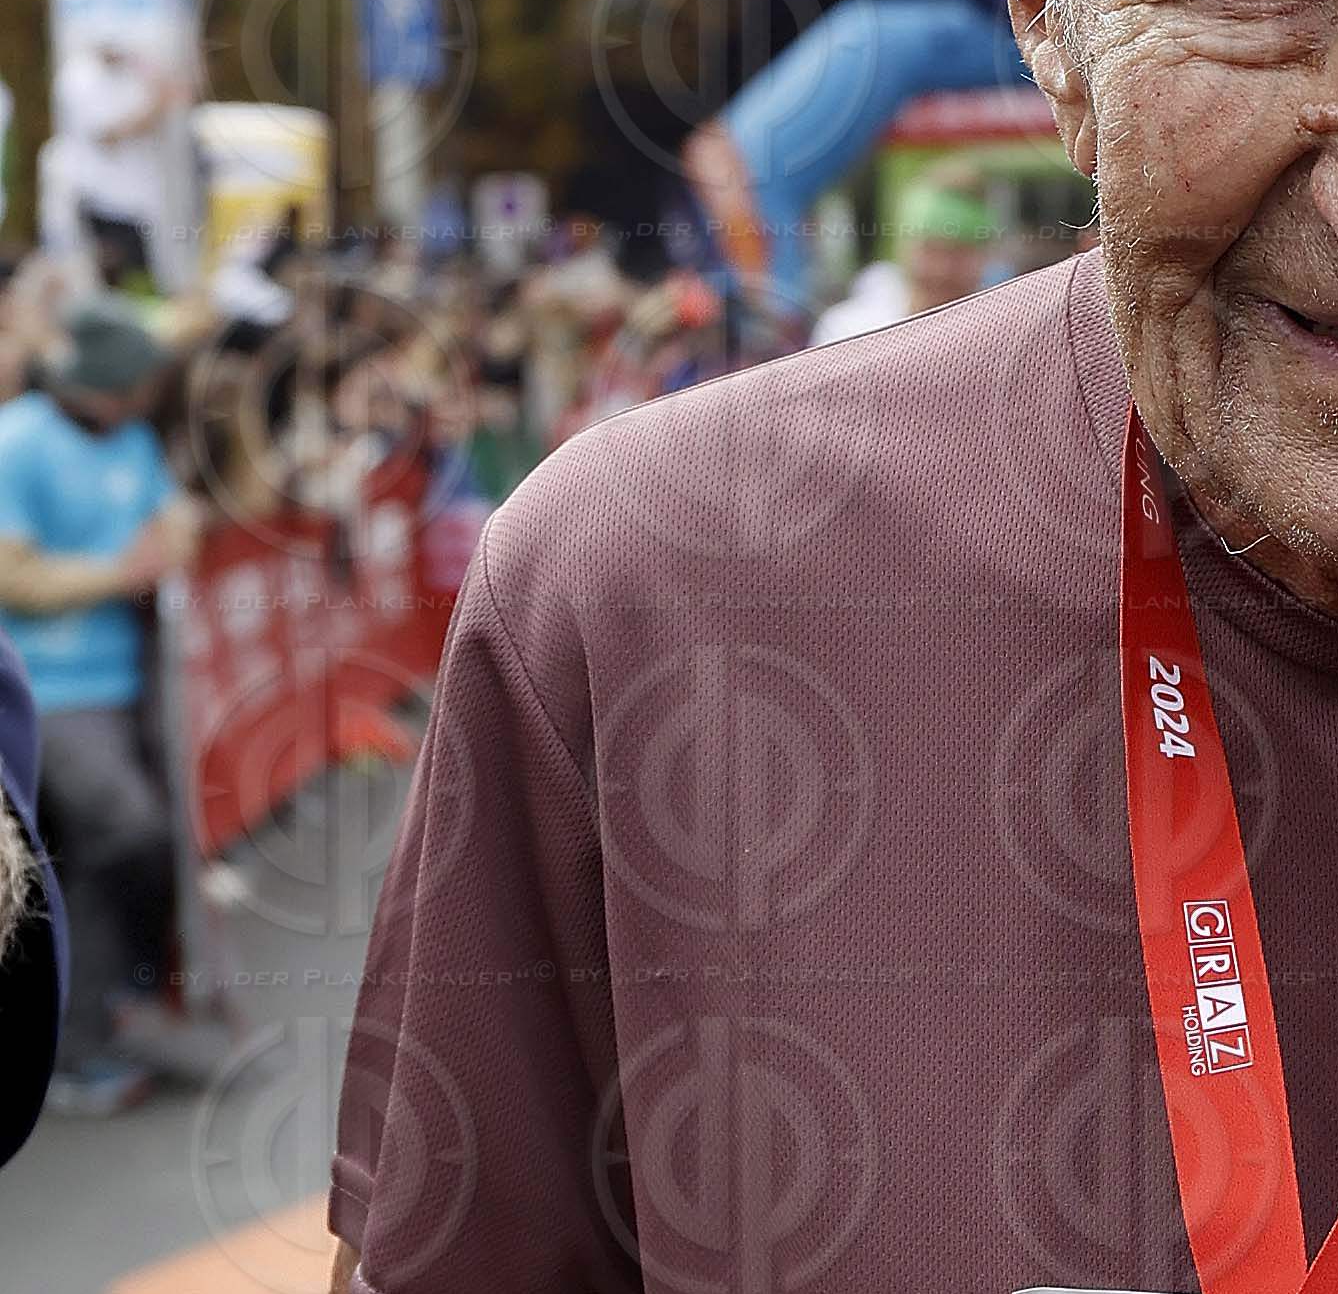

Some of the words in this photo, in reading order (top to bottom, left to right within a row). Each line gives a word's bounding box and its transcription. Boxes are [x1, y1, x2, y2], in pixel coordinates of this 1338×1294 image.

[1149, 656, 1196, 759] 2024
[1187, 904, 1249, 1069] GRAZ
[1182, 1005, 1206, 1076] HOLDING
